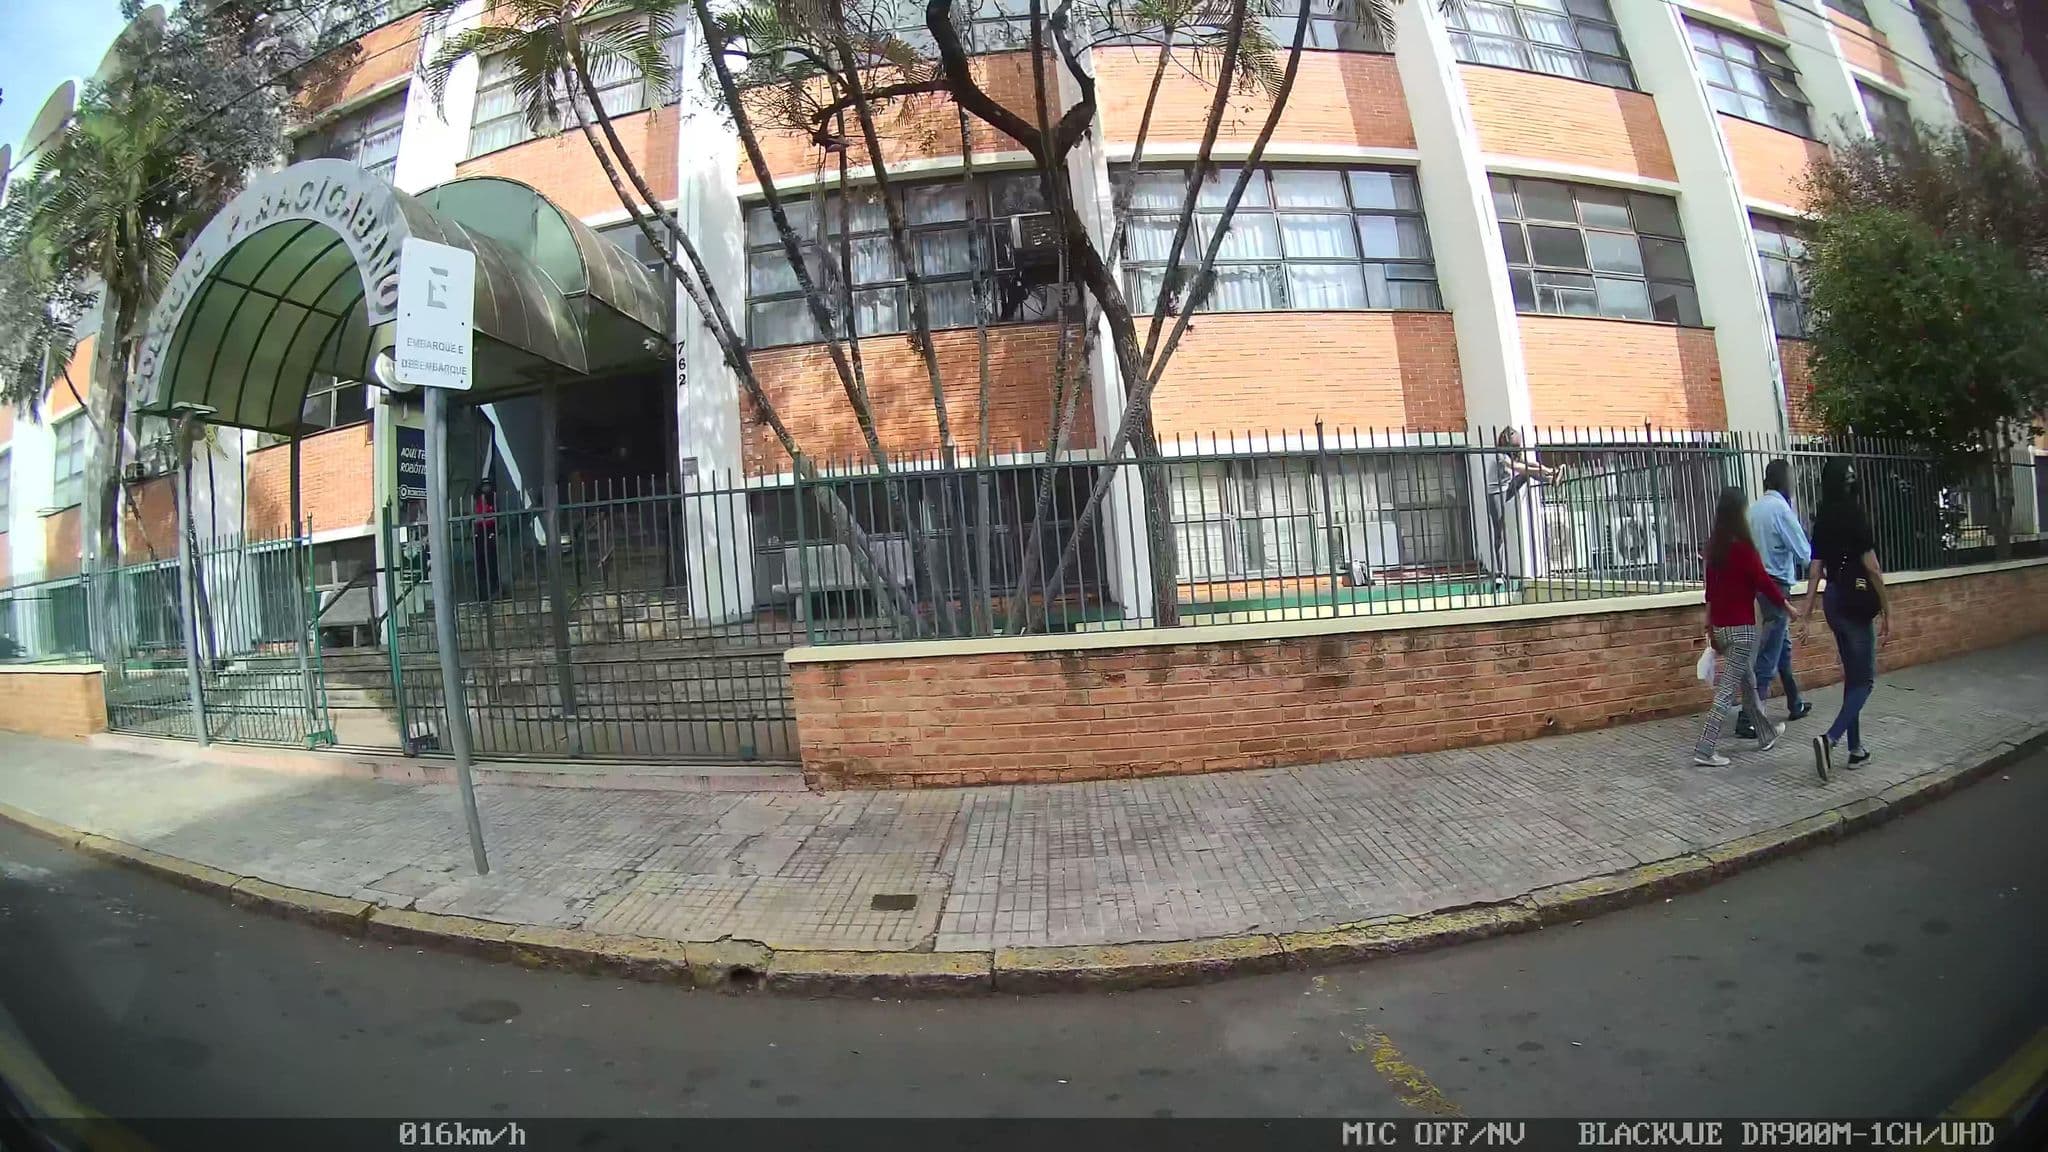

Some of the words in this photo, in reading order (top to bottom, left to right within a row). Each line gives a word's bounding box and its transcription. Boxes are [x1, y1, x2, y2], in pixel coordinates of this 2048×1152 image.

[407, 337, 456, 353] EMBARQUE
[458, 344, 464, 355] E
[401, 359, 468, 376] DESEMBARQUE
[678, 340, 686, 386] 762
